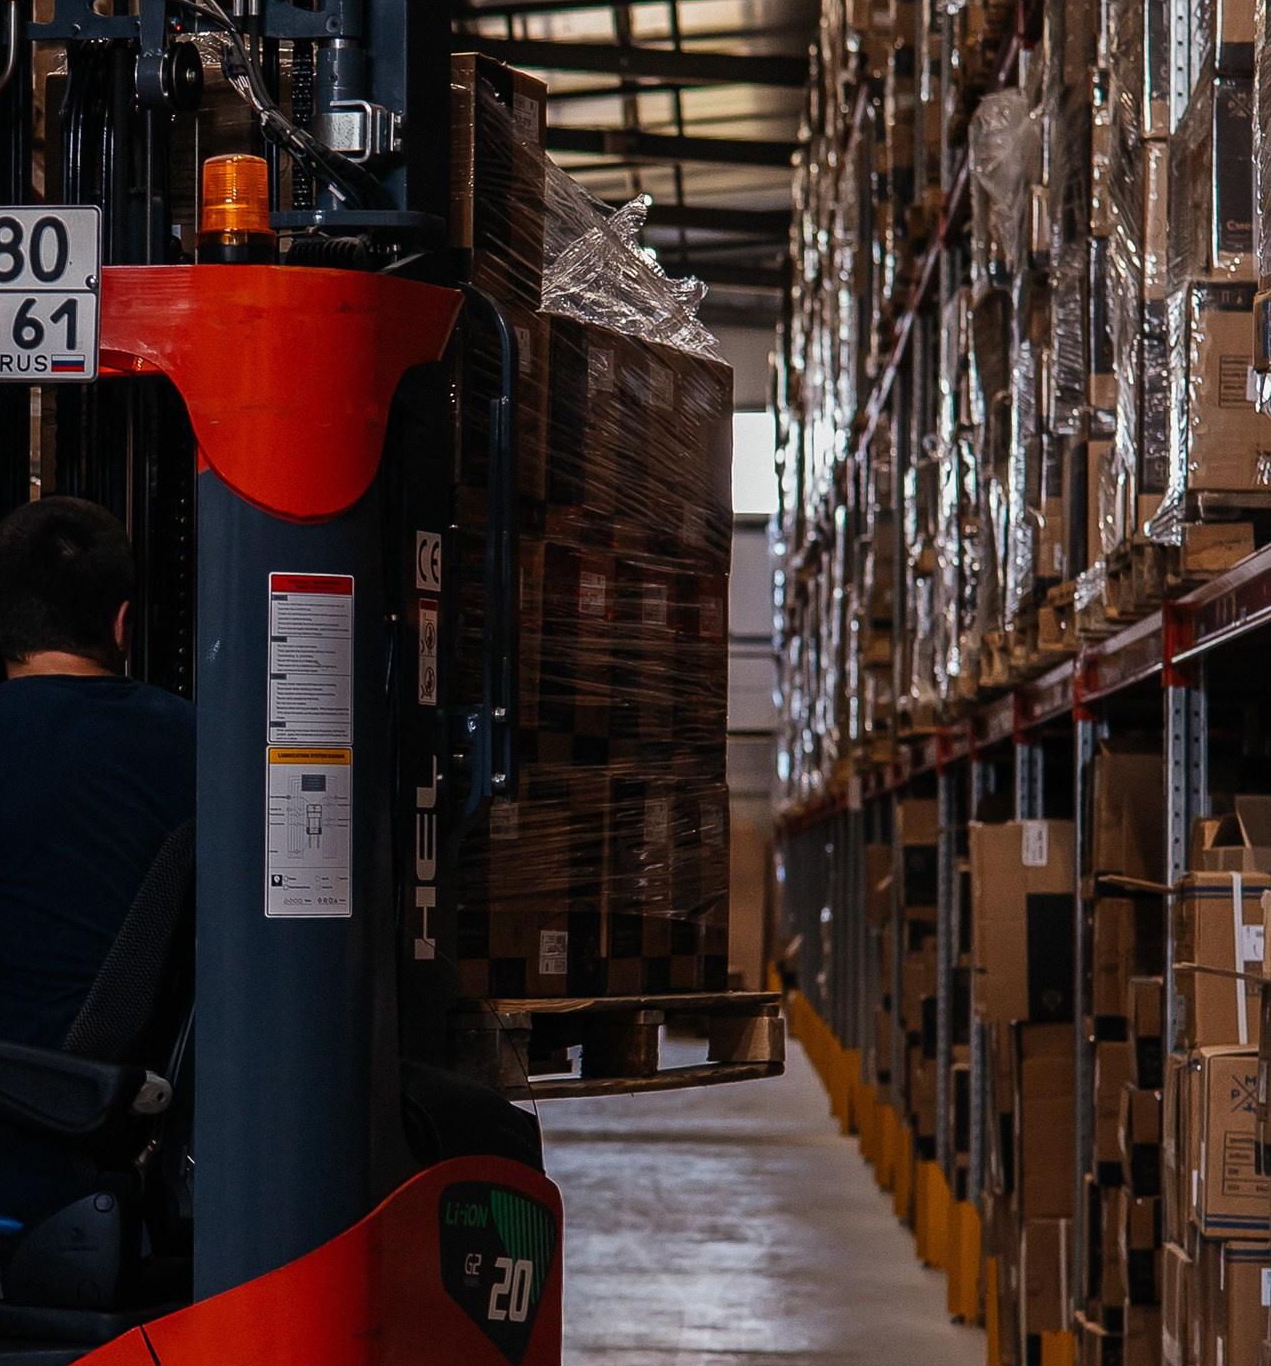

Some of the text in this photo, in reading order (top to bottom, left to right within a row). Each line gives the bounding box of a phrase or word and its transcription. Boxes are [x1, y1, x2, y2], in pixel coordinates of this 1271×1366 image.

[11, 297, 79, 351] 61
[0, 354, 48, 372] RUS
[418, 538, 440, 584] CE
[464, 1252, 483, 1275] G2
[487, 1257, 534, 1323] 20
